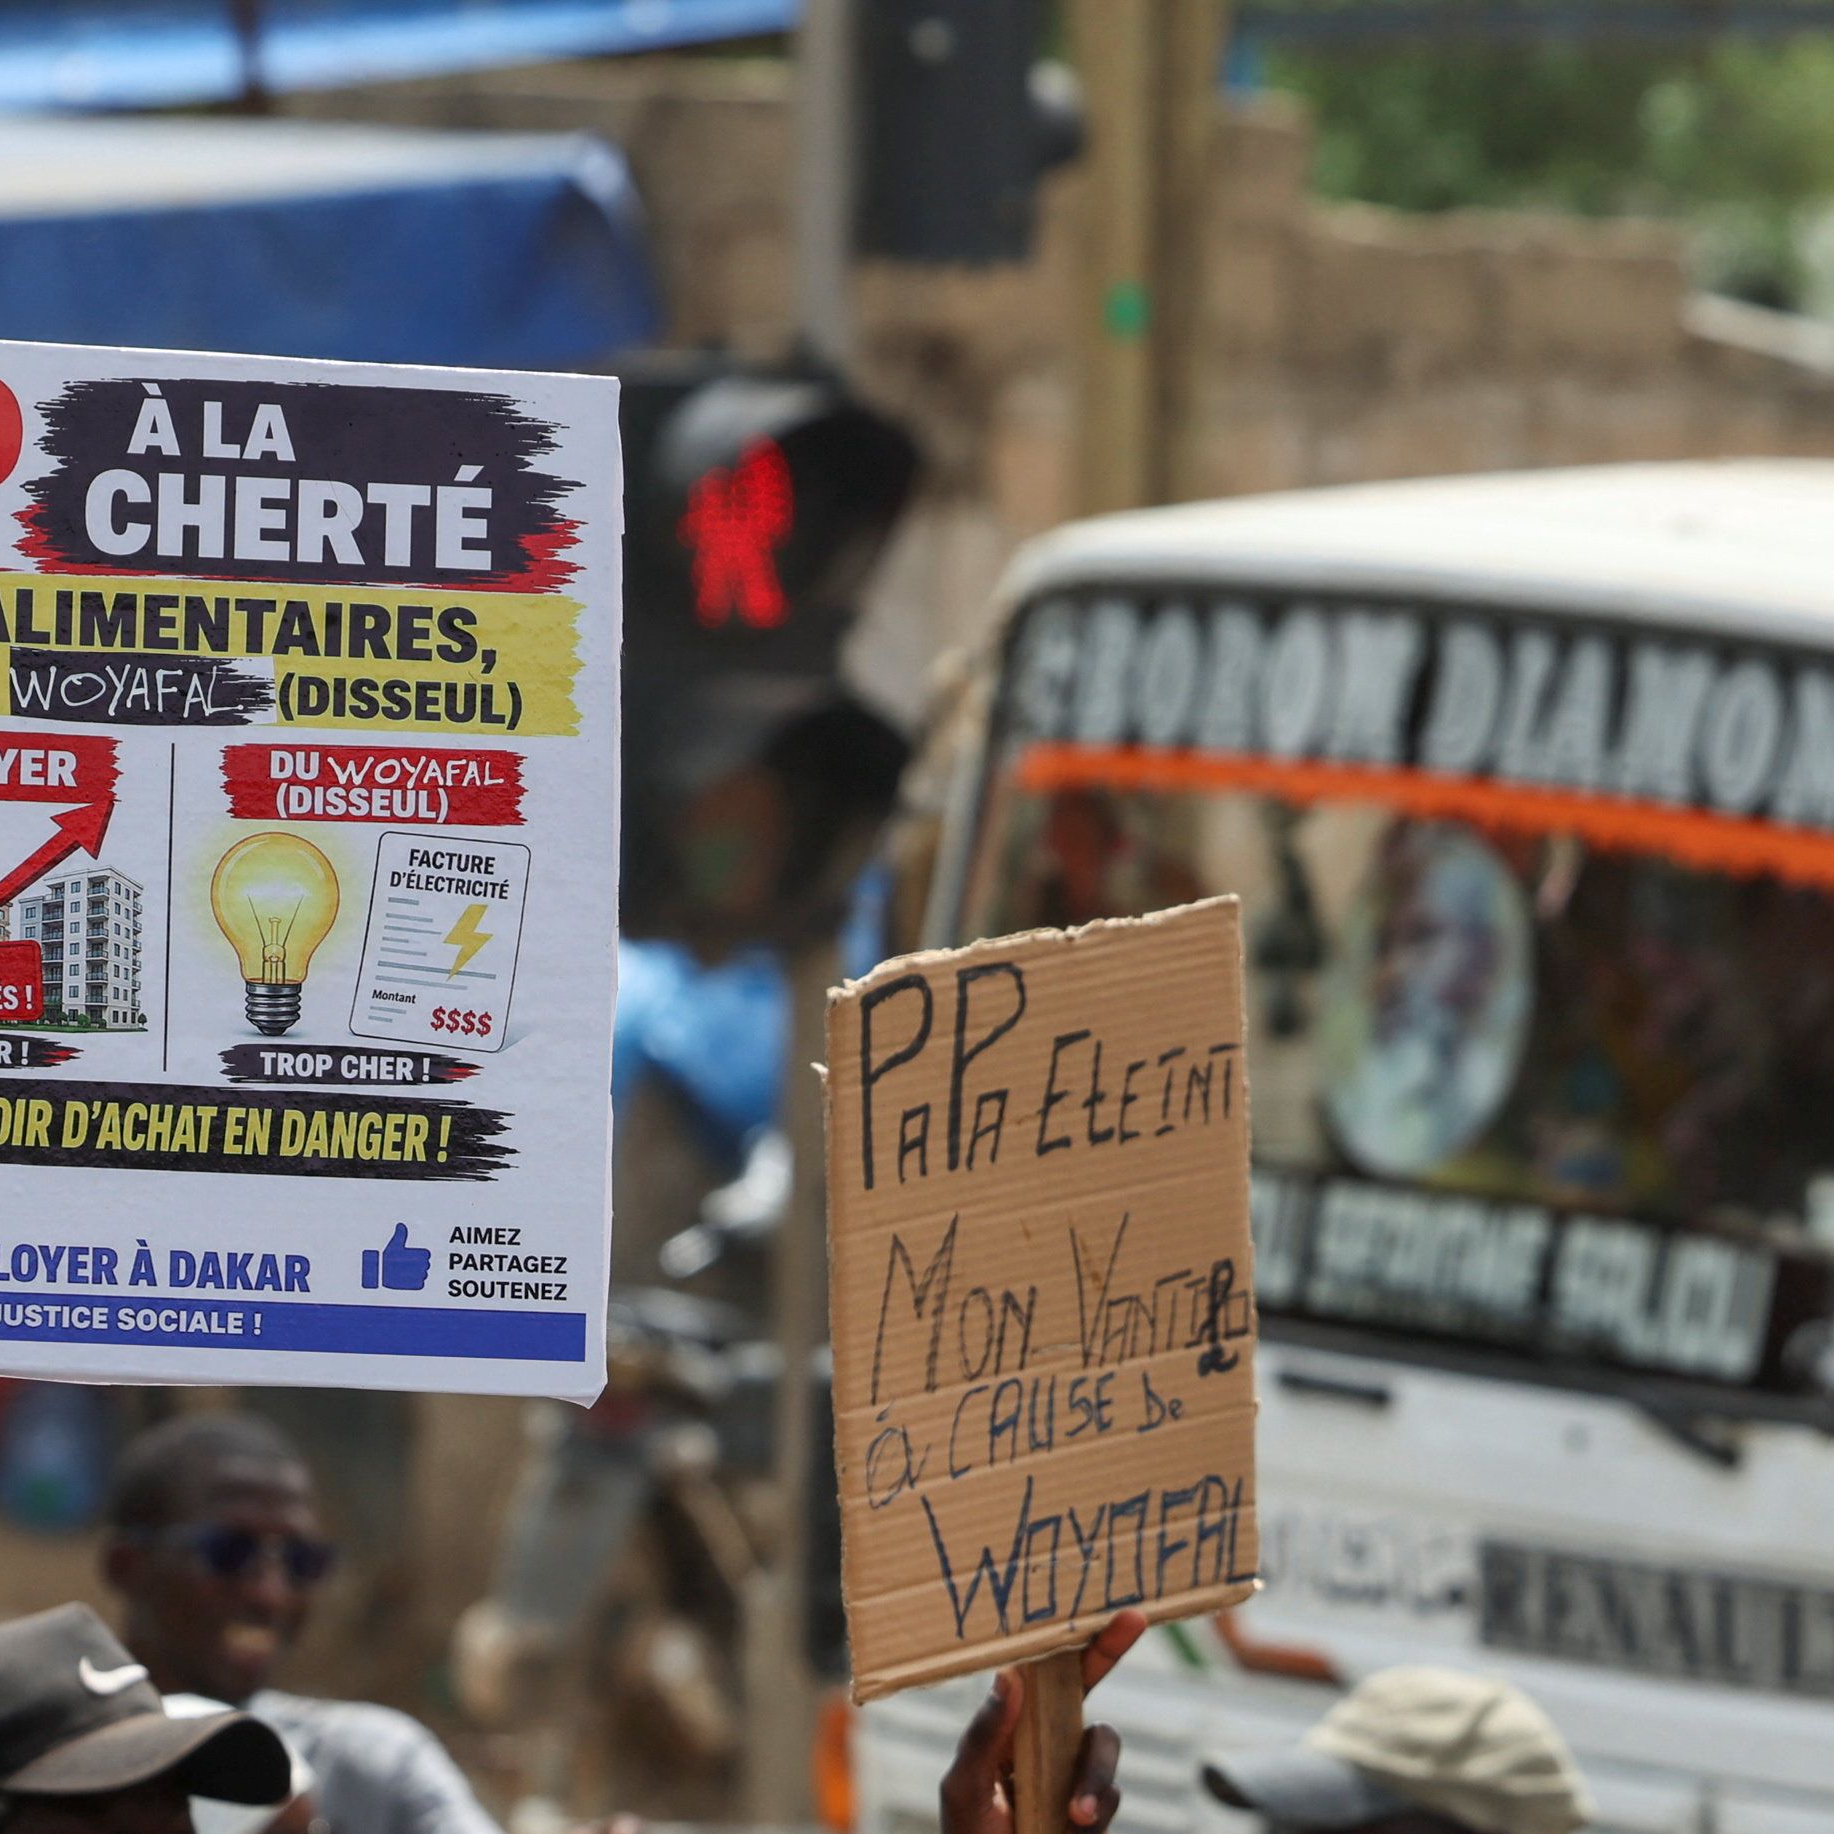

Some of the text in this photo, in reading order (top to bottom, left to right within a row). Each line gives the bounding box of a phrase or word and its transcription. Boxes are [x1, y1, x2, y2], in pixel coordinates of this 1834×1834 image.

[126, 383, 296, 462] À LA
[84, 465, 493, 571] CHERTÉ
[9, 663, 244, 719] WOYAFAL
[278, 672, 522, 730] (DISSEUL)
[270, 751, 504, 789] DU WOYAFAL
[276, 782, 449, 824] (DISSEUL)
[408, 848, 496, 875] FACTURE
[371, 989, 416, 1004] Montant
[430, 1006, 493, 1038] $$$$
[260, 1051, 333, 1078] TROP
[340, 1055, 414, 1081] CHER
[61, 1101, 218, 1154] D'ACHAT
[223, 1106, 272, 1156] EN
[279, 1109, 430, 1162] DANGER
[449, 1226, 521, 1246] AIMEZ
[129, 1239, 157, 1287] À
[169, 1249, 310, 1293] DAKAR
[448, 1253, 567, 1275] PARTAGEZ
[448, 1280, 567, 1301] SOUTENEZ
[117, 1308, 243, 1335] SOCIALE
[949, 1372, 1115, 1480] CAUSE
[921, 1475, 1258, 1640] WOYOFAL
